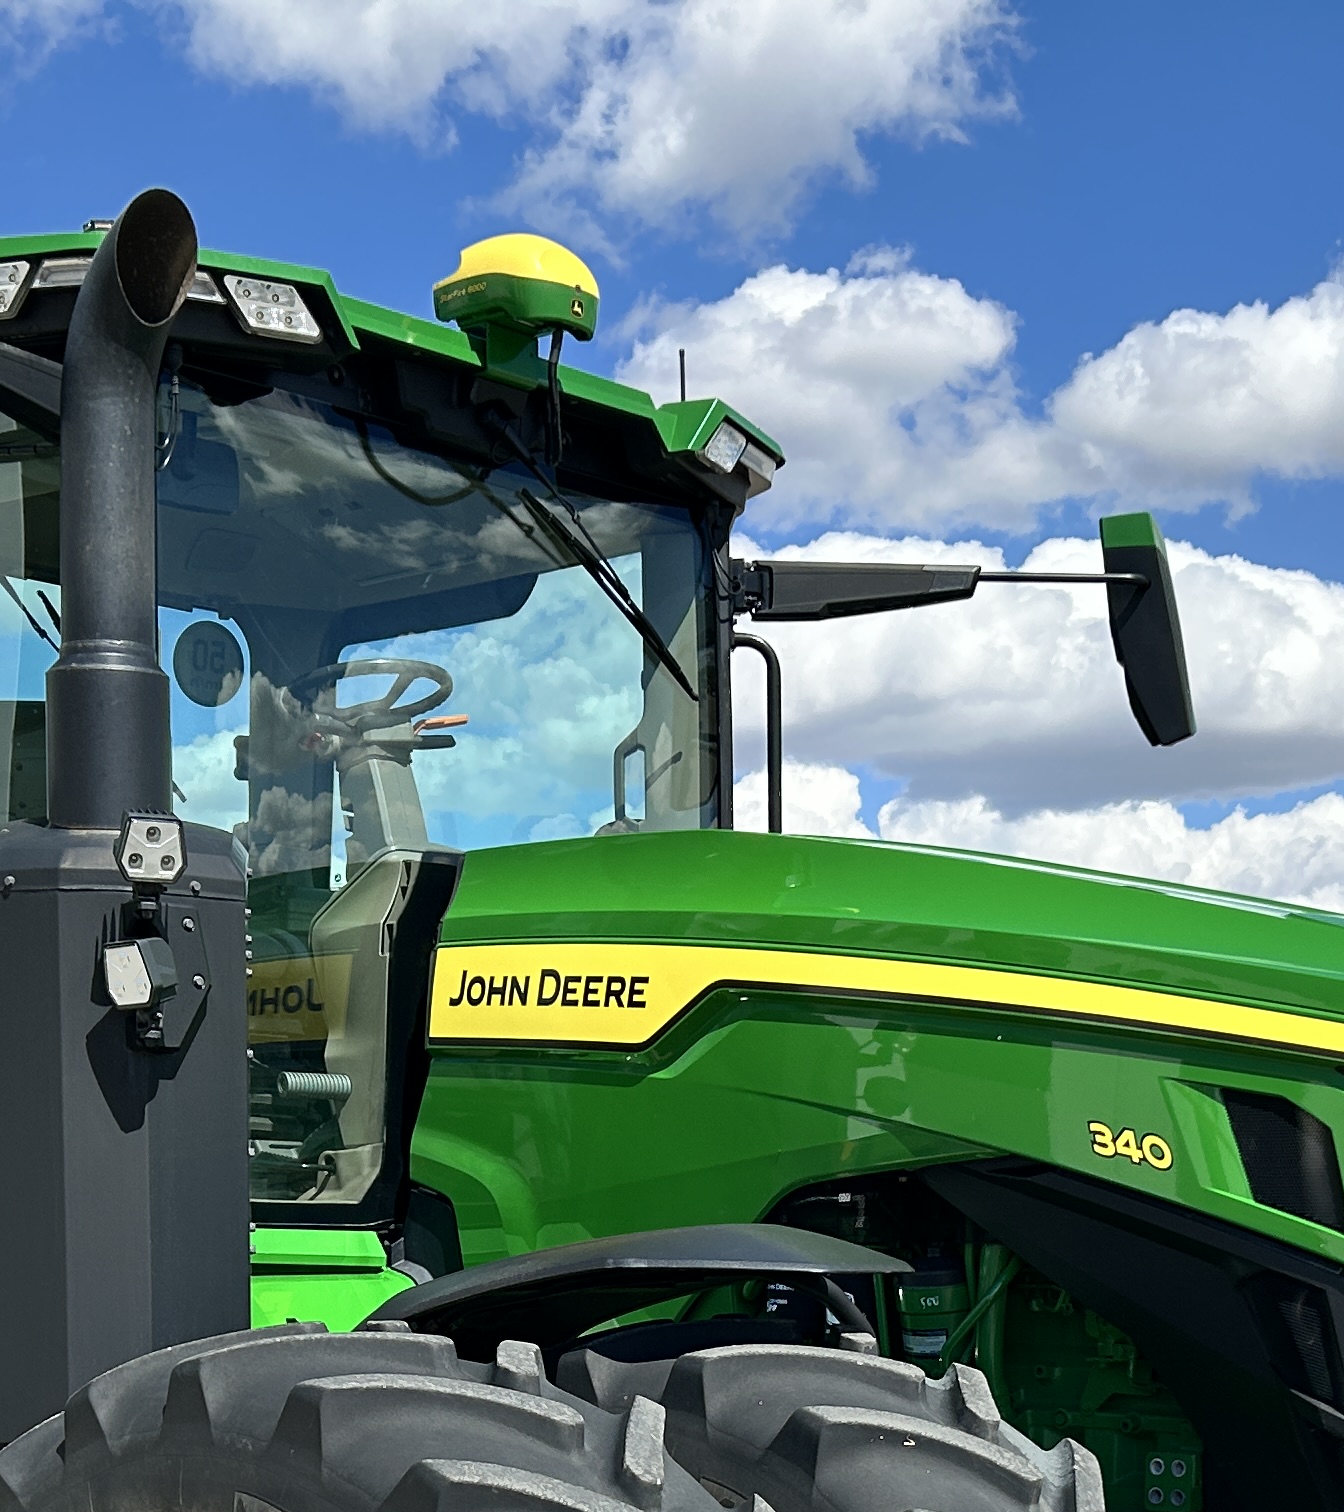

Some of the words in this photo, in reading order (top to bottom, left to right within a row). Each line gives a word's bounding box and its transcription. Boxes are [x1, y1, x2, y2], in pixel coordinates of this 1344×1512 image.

[449, 970, 531, 1008] JOHN
[536, 968, 650, 1009] DEERE
[1087, 1120, 1173, 1171] 340
